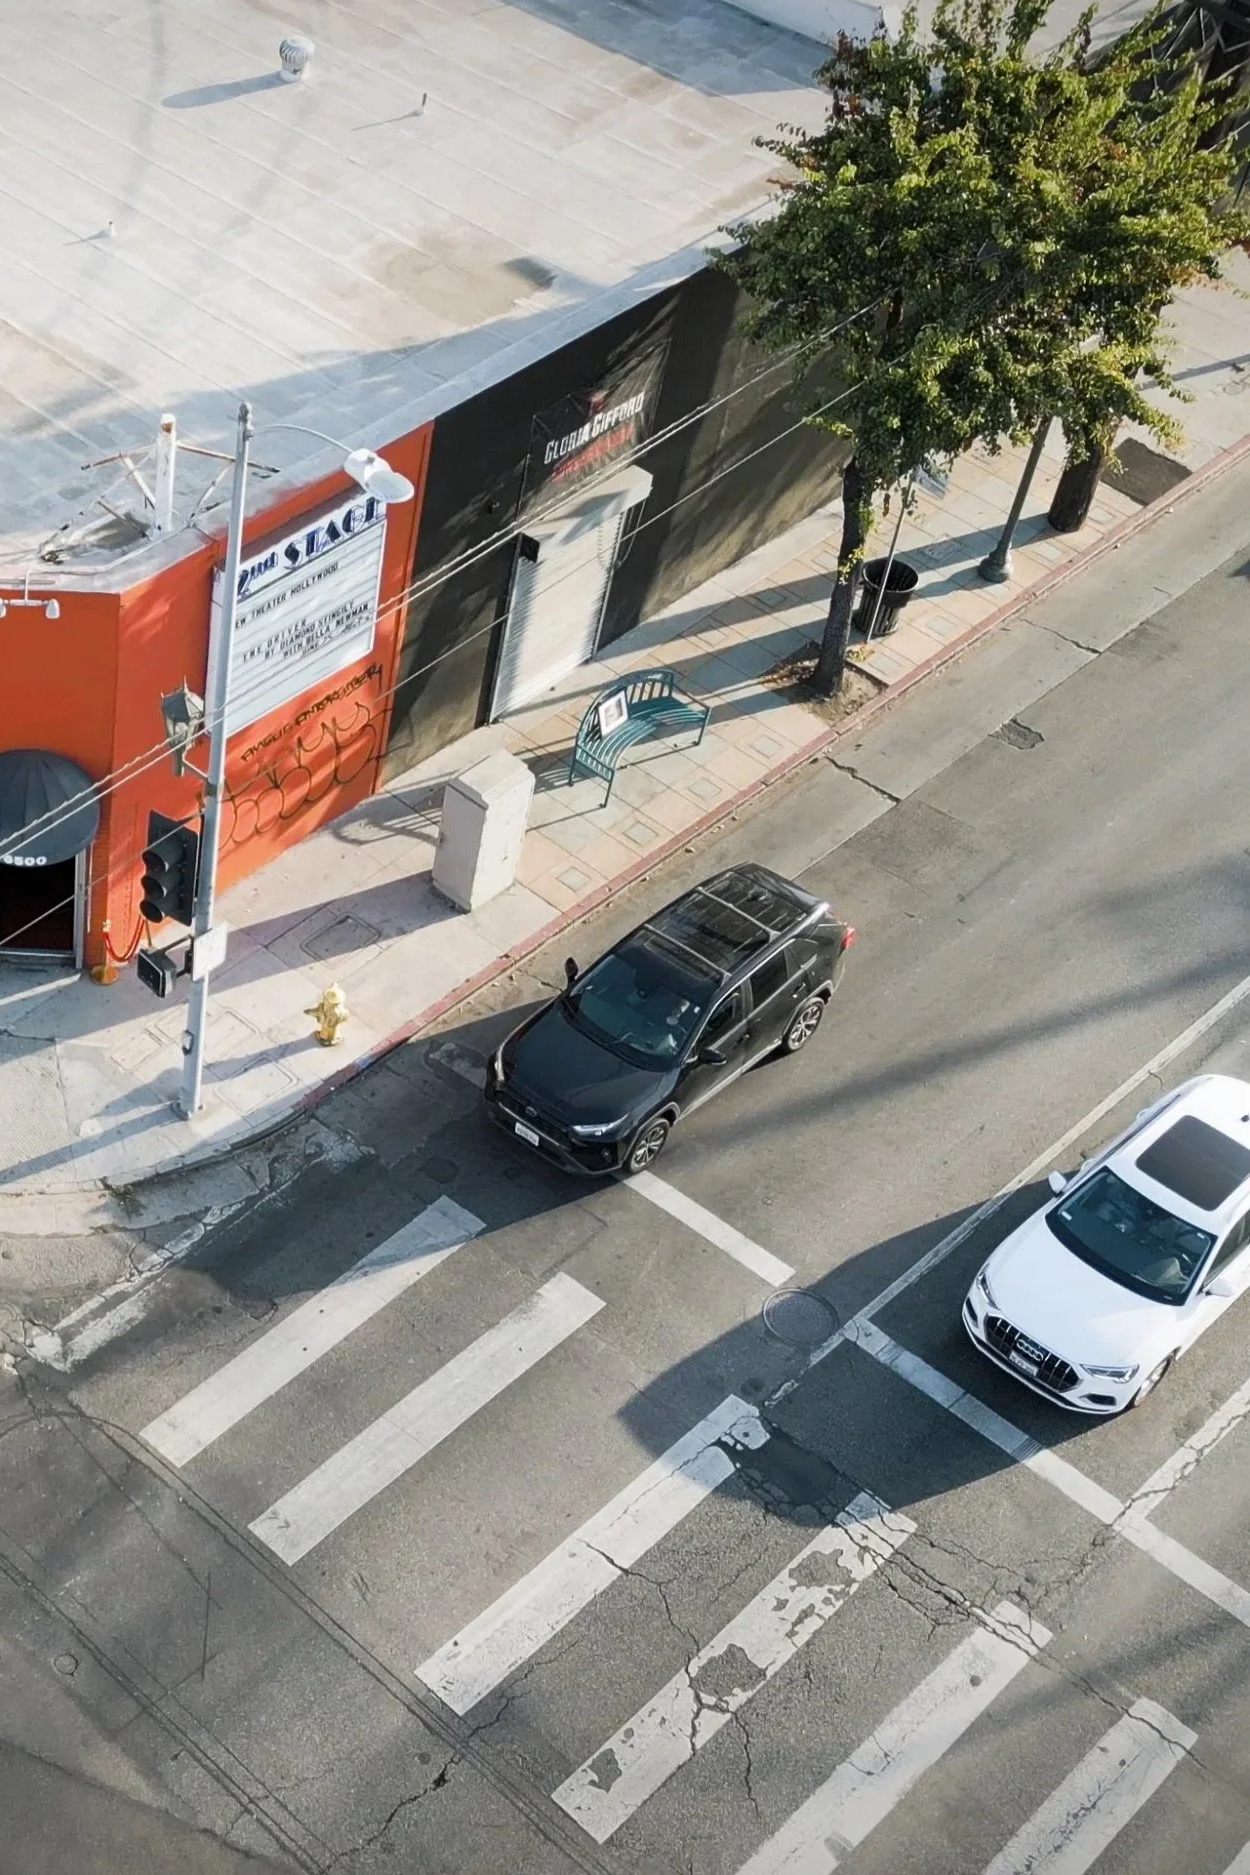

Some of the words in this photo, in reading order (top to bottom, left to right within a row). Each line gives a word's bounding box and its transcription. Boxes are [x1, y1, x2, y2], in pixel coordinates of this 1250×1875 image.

[544, 421, 592, 465] GLORIA
[592, 391, 646, 438] GIFFORD
[251, 593, 286, 618] THEATER
[290, 562, 339, 598] HOLLYWOOD
[243, 645, 262, 663] THE
[267, 618, 307, 648] DRIVER
[264, 648, 275, 660] BY
[280, 624, 316, 650] DIAMOND
[283, 640, 303, 659] WITH
[306, 625, 331, 645] BELLA
[335, 602, 369, 628] NEWMAN
